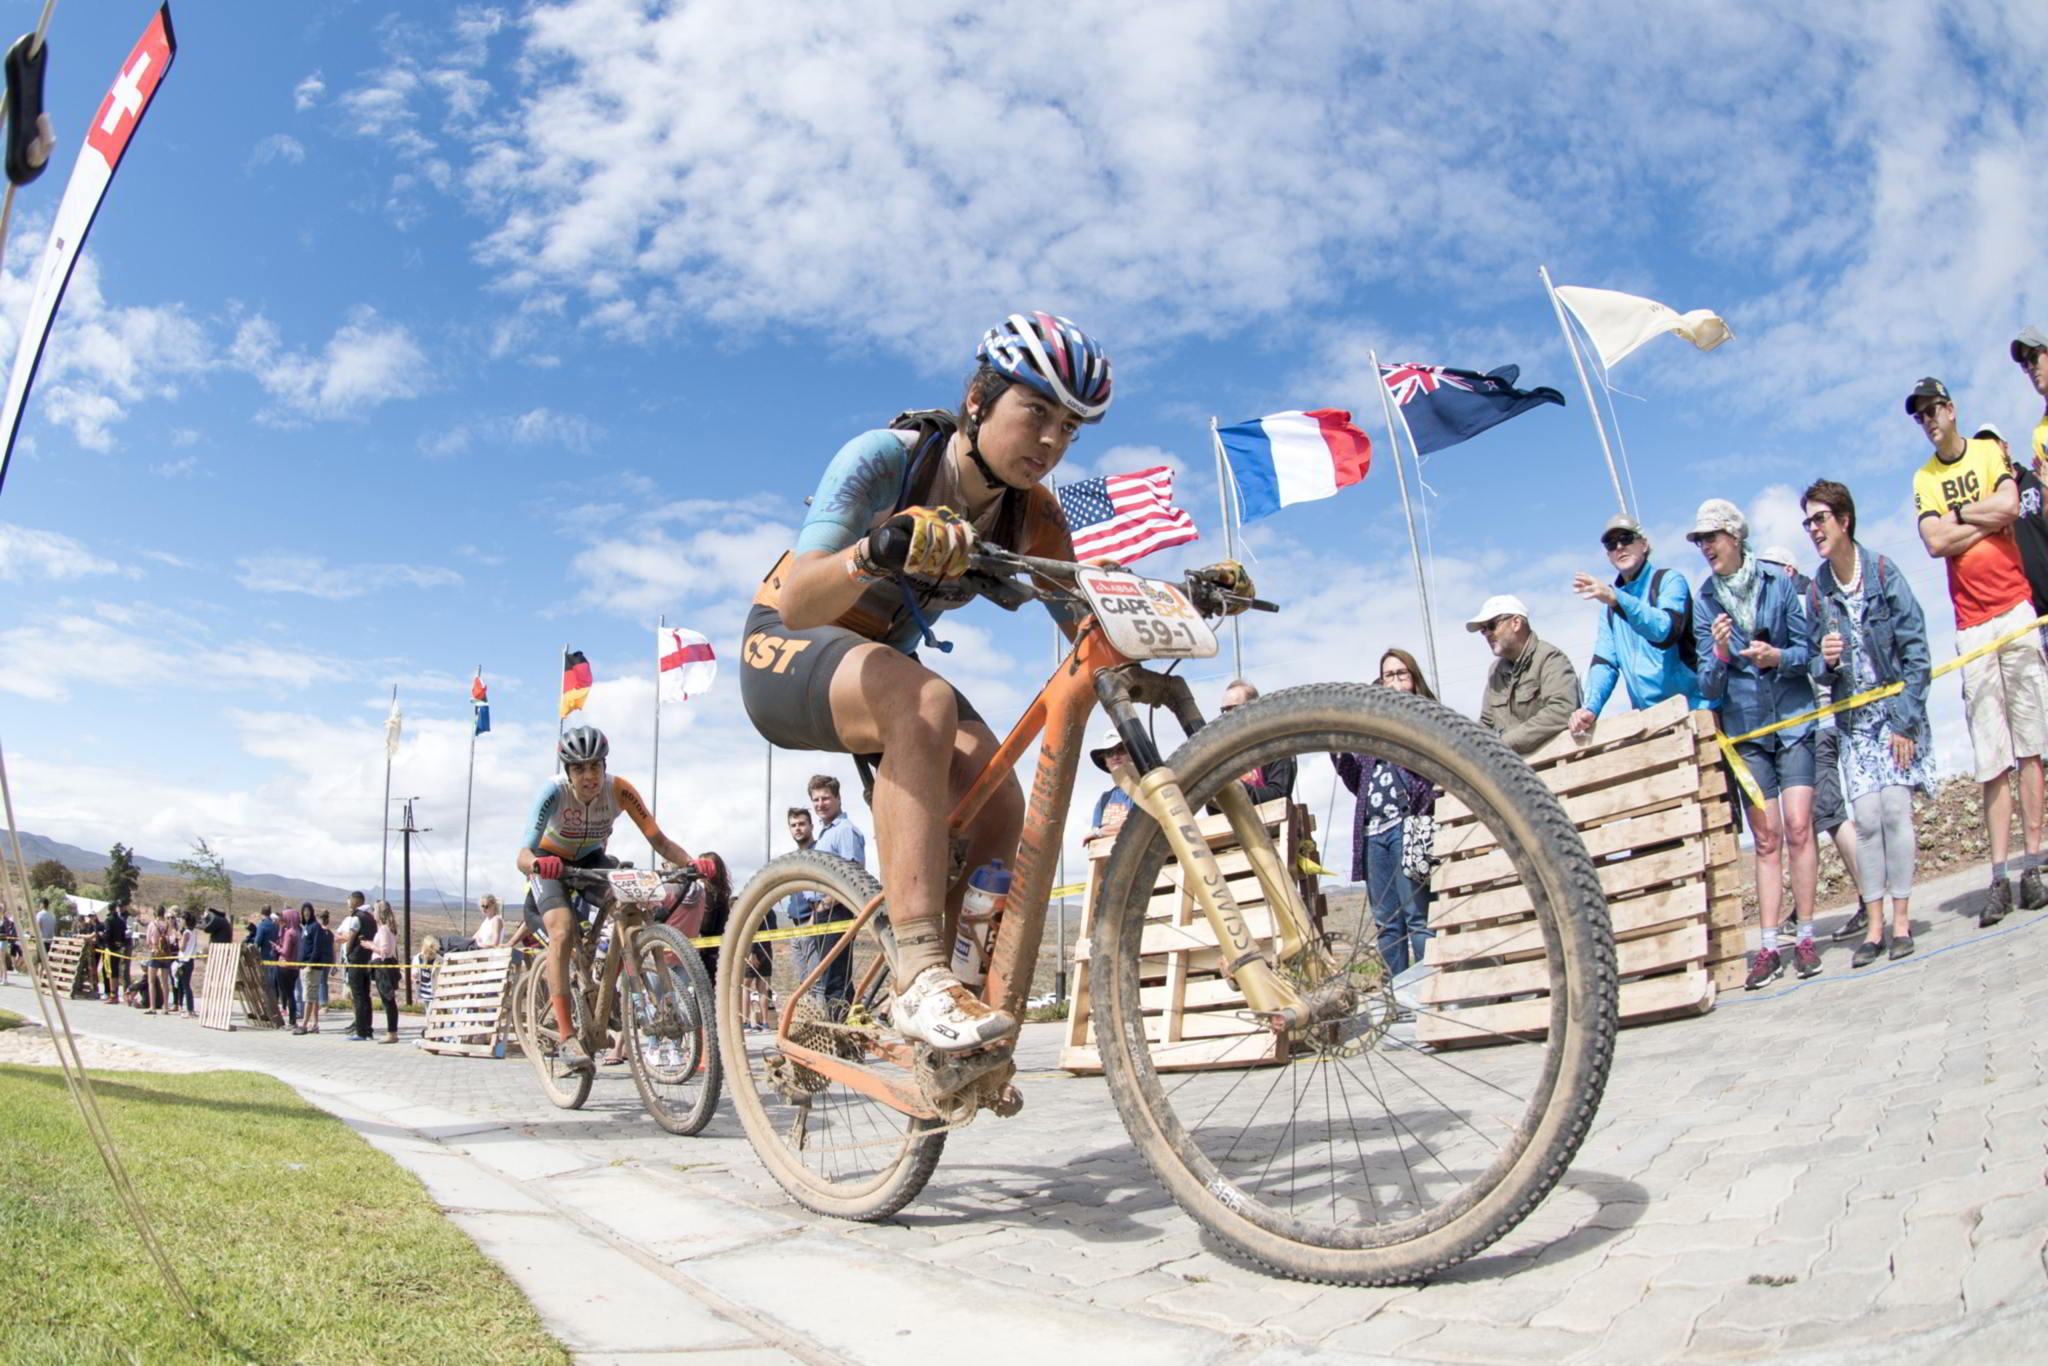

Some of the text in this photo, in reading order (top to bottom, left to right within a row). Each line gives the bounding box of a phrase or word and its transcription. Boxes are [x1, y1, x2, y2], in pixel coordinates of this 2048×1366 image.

[1941, 470, 1979, 502] BIG
[1100, 597, 1155, 617] CAPE
[1132, 619, 1197, 646] 59-1
[743, 632, 812, 674] CST
